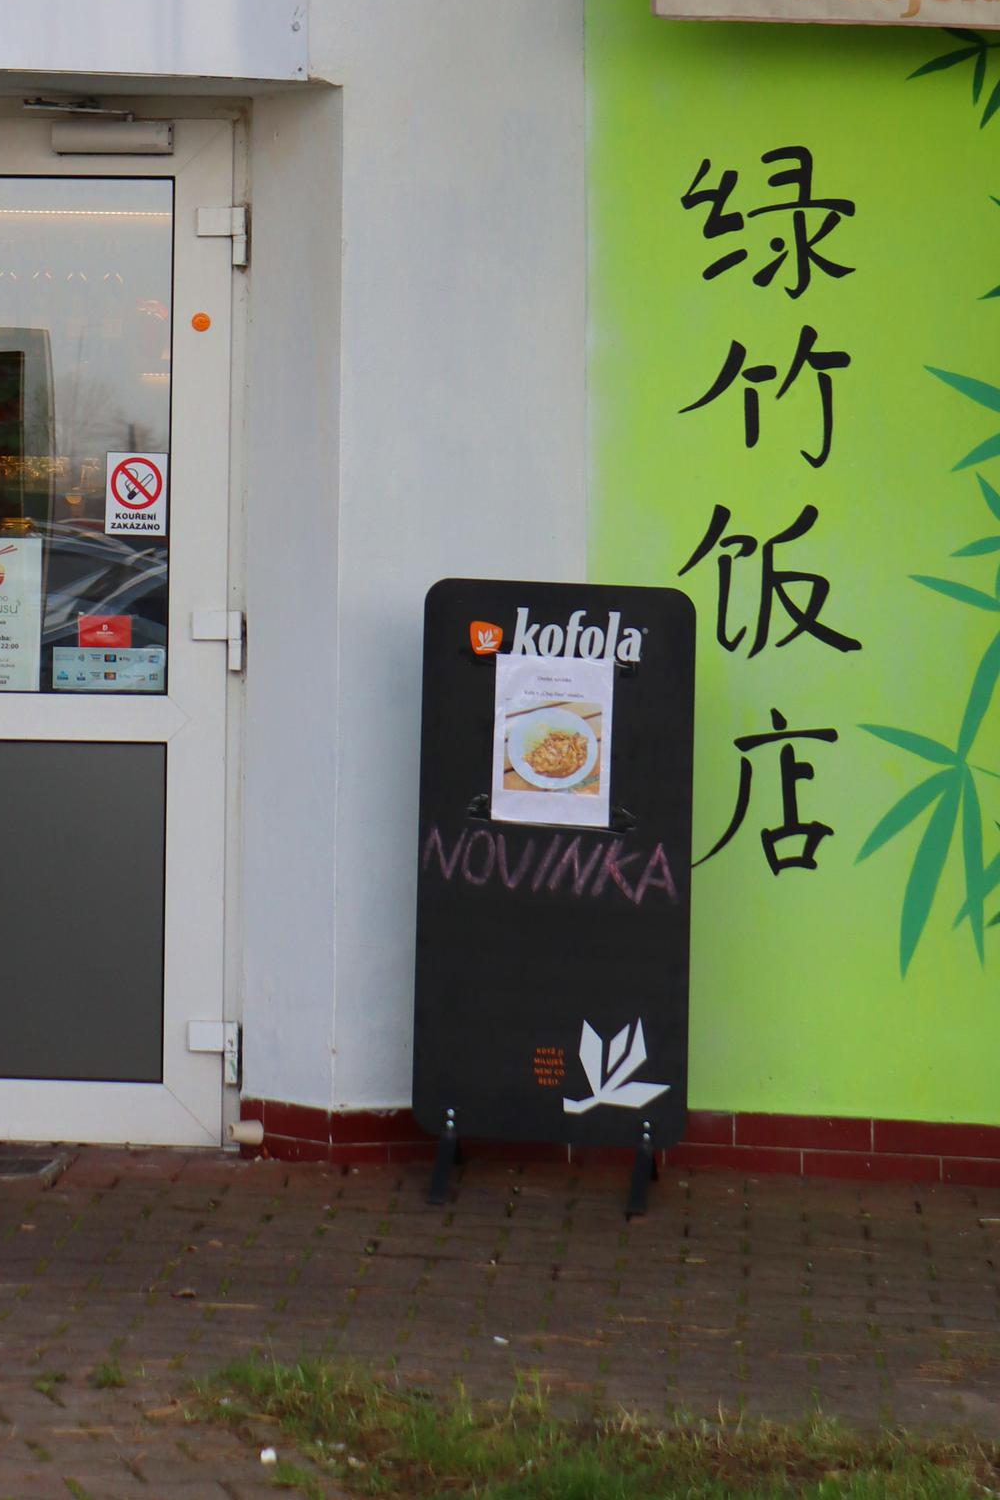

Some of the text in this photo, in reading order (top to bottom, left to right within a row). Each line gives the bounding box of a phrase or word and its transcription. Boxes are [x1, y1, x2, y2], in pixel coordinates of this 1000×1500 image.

[111, 522, 160, 531] ZAKÁZÁNO
[115, 512, 157, 521] KOUŘENÍ
[678, 145, 863, 877] 绿竹饭店
[510, 607, 642, 662] kofola
[422, 827, 679, 906] NOVINKA
